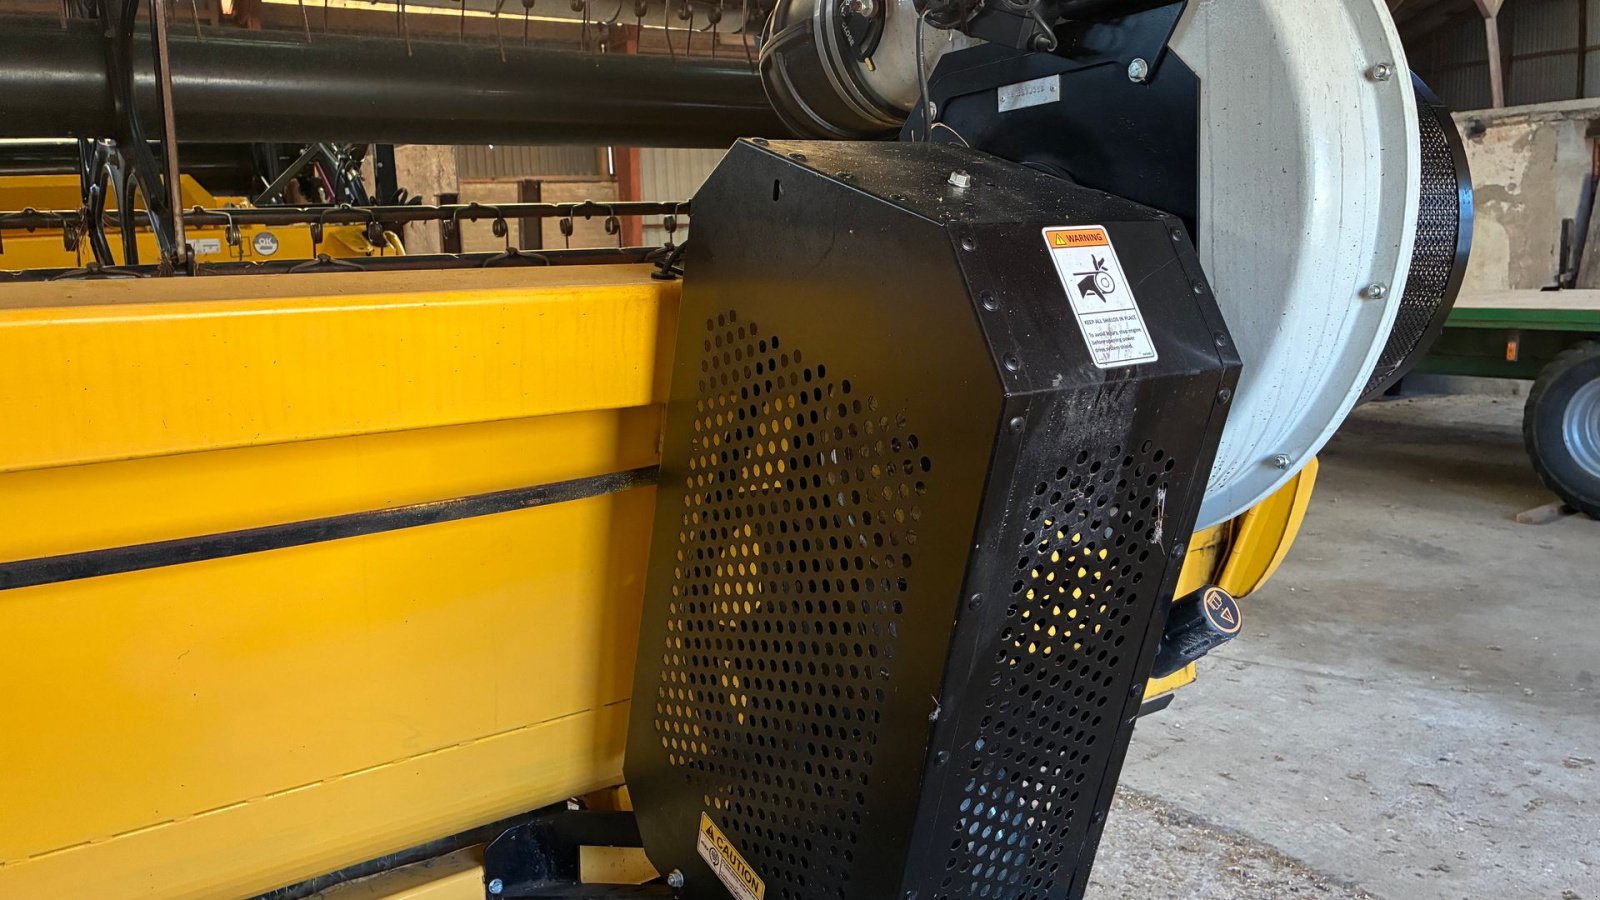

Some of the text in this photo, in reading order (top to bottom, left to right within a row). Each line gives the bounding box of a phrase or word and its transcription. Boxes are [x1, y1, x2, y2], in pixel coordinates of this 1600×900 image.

[258, 237, 273, 245] OK
[1066, 233, 1102, 242] WARNING
[716, 836, 759, 893] CAUTION
